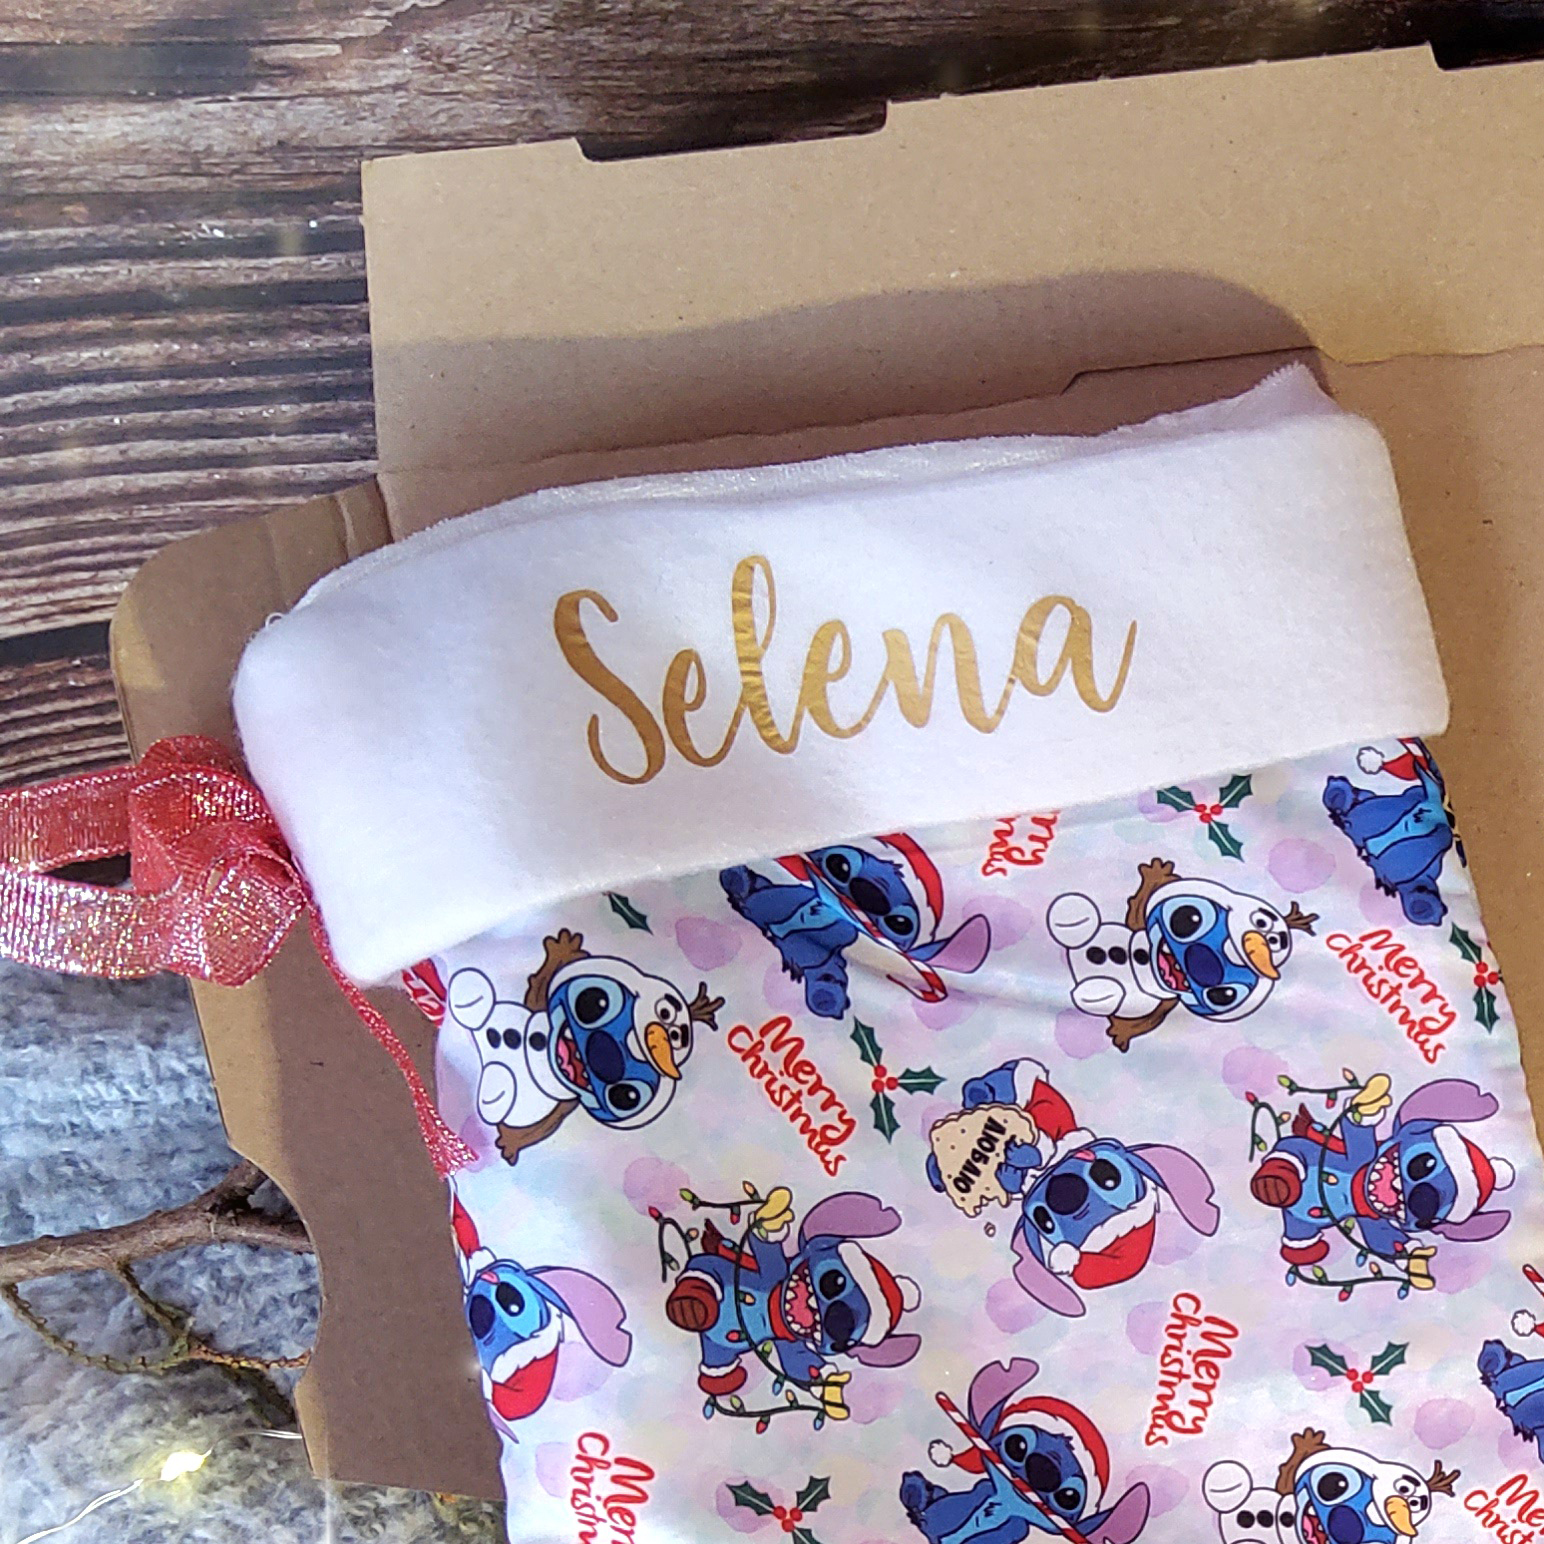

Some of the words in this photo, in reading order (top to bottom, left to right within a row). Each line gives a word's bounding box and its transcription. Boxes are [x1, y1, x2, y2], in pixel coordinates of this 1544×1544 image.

[553, 553, 1138, 785] Selena
[1003, 811, 1058, 866] rry
[1325, 933, 1446, 1065] Christmas
[1358, 928, 1457, 1036] Merry
[727, 1024, 847, 1177] Christmas
[758, 1015, 857, 1146] Merry
[1144, 1292, 1204, 1447] Christmas
[1163, 1315, 1238, 1434] Merry
